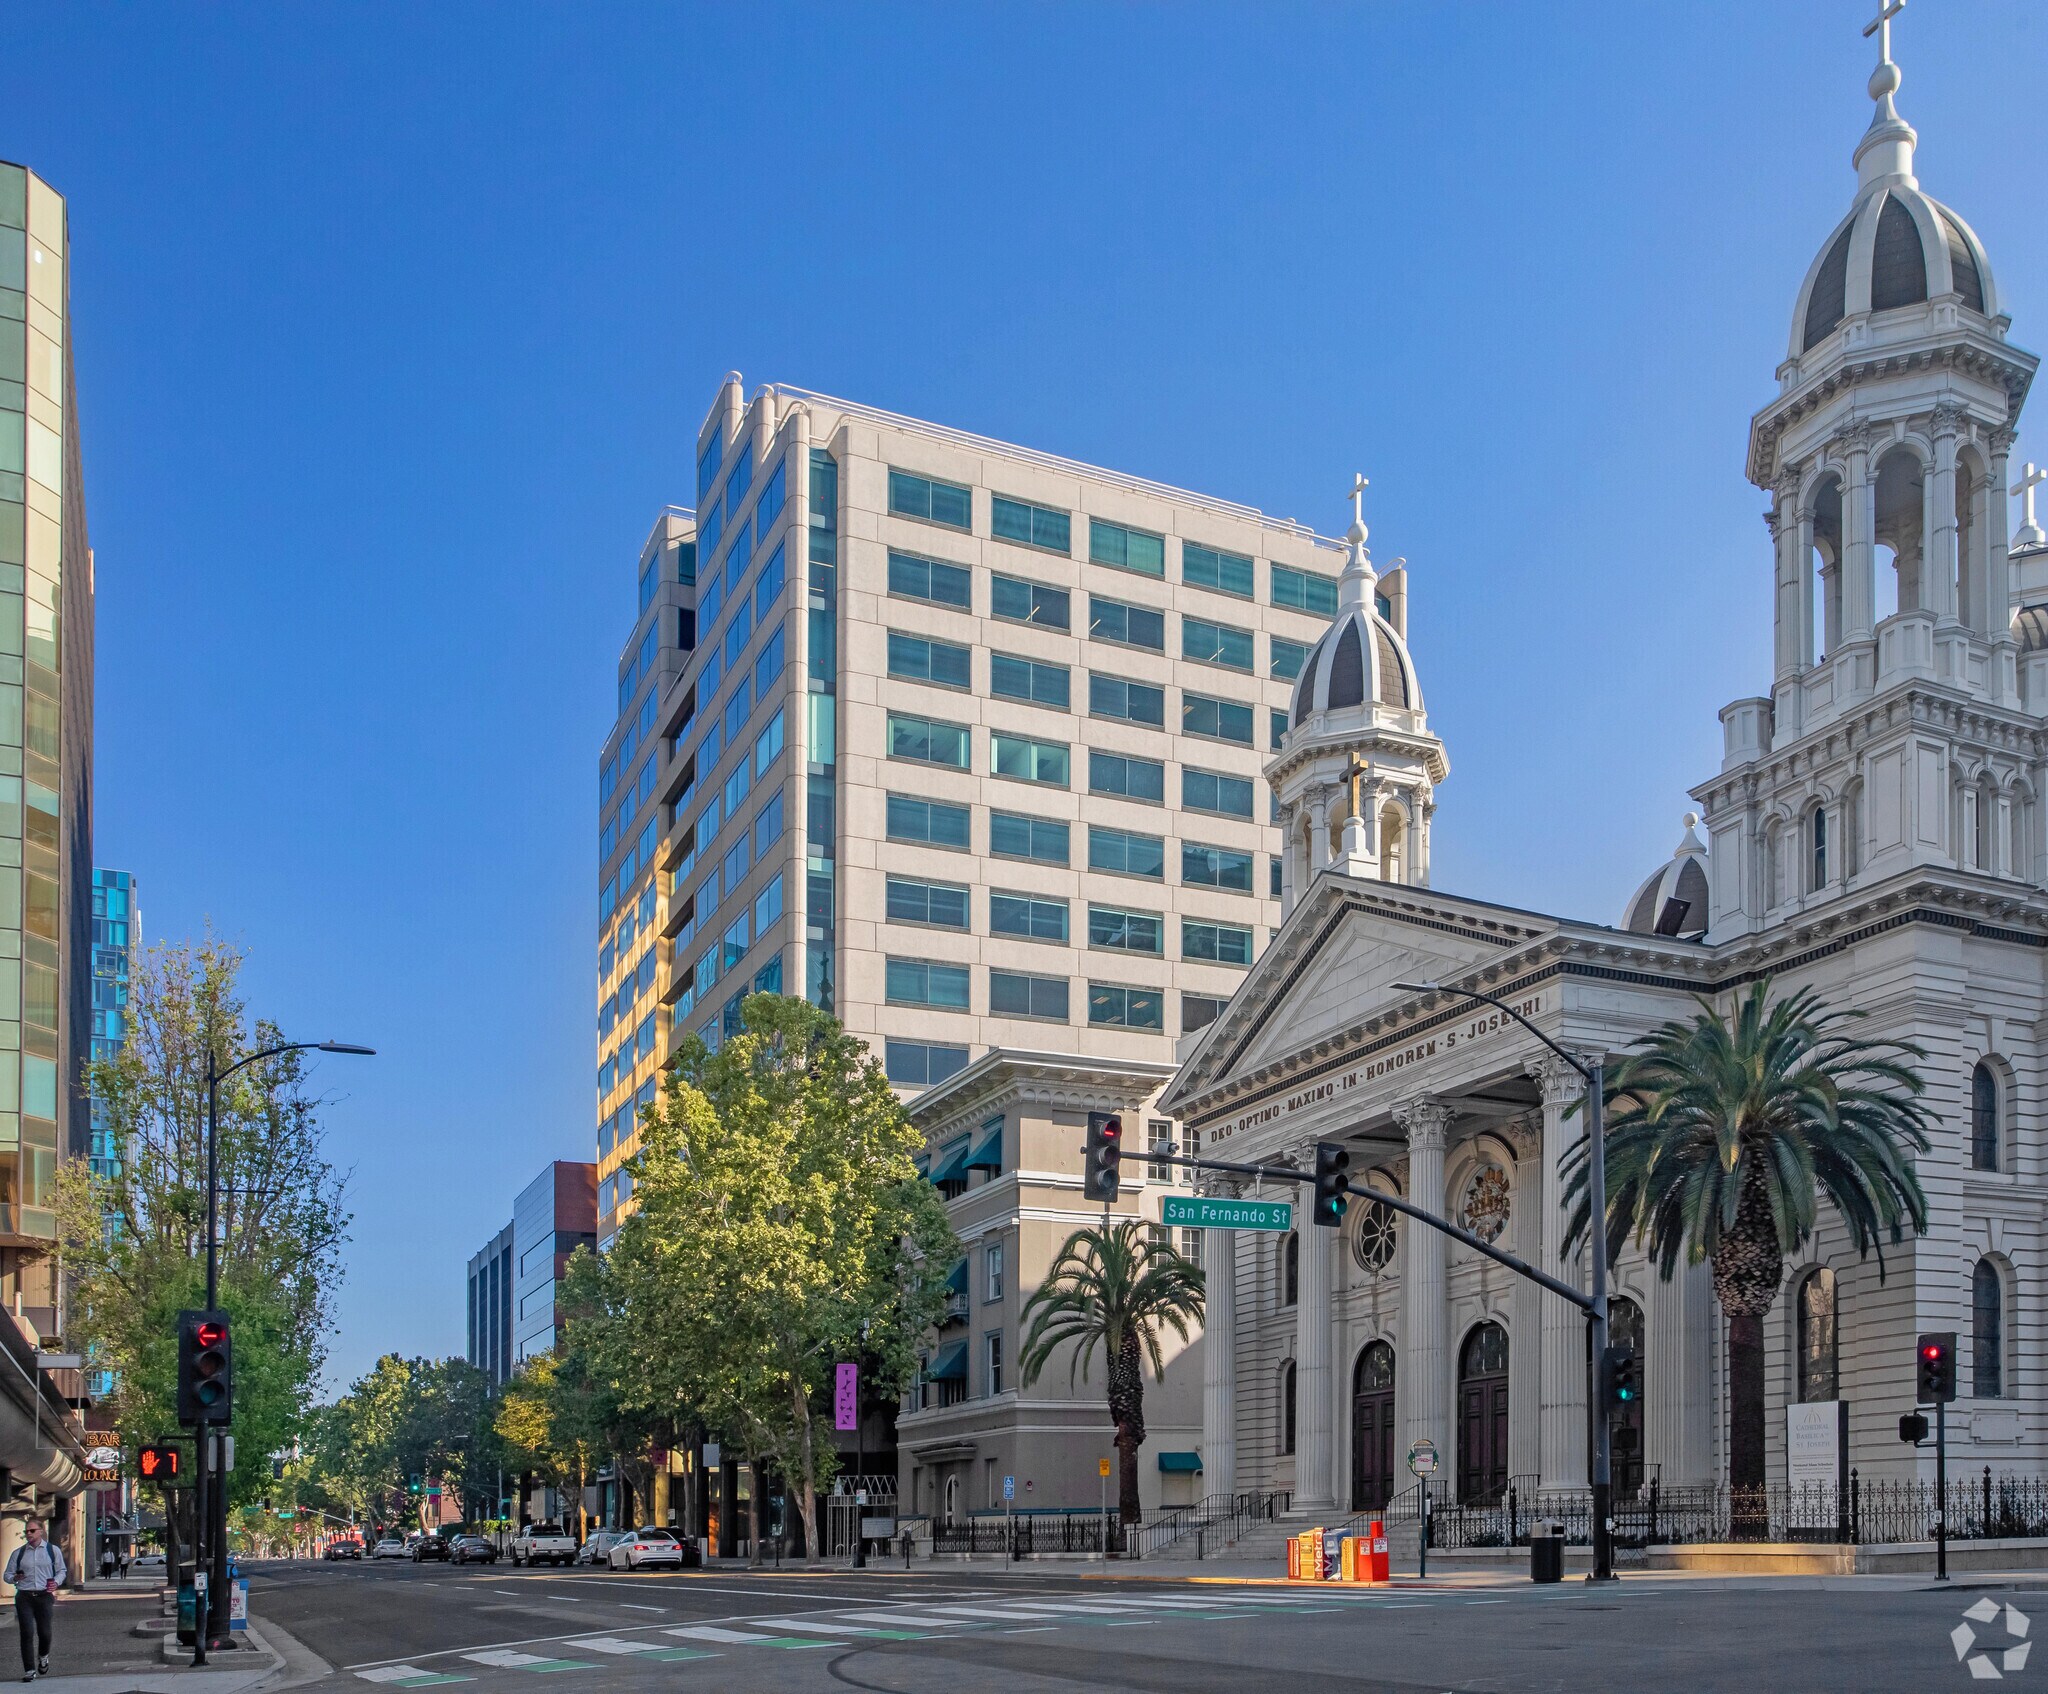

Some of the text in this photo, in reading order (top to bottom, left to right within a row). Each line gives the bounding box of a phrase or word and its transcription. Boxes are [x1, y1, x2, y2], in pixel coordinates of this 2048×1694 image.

[1210, 1124, 1232, 1143] DEO
[1239, 1105, 1280, 1131] OPTIMO
[1287, 1083, 1333, 1111] MAXIMO
[1342, 1072, 1357, 1090] IN
[1366, 1040, 1436, 1080] HONOREM
[1168, 1203, 1288, 1224] San Fernando St
[86, 1433, 120, 1447] BAR
[83, 1469, 120, 1481] LOUNGE
